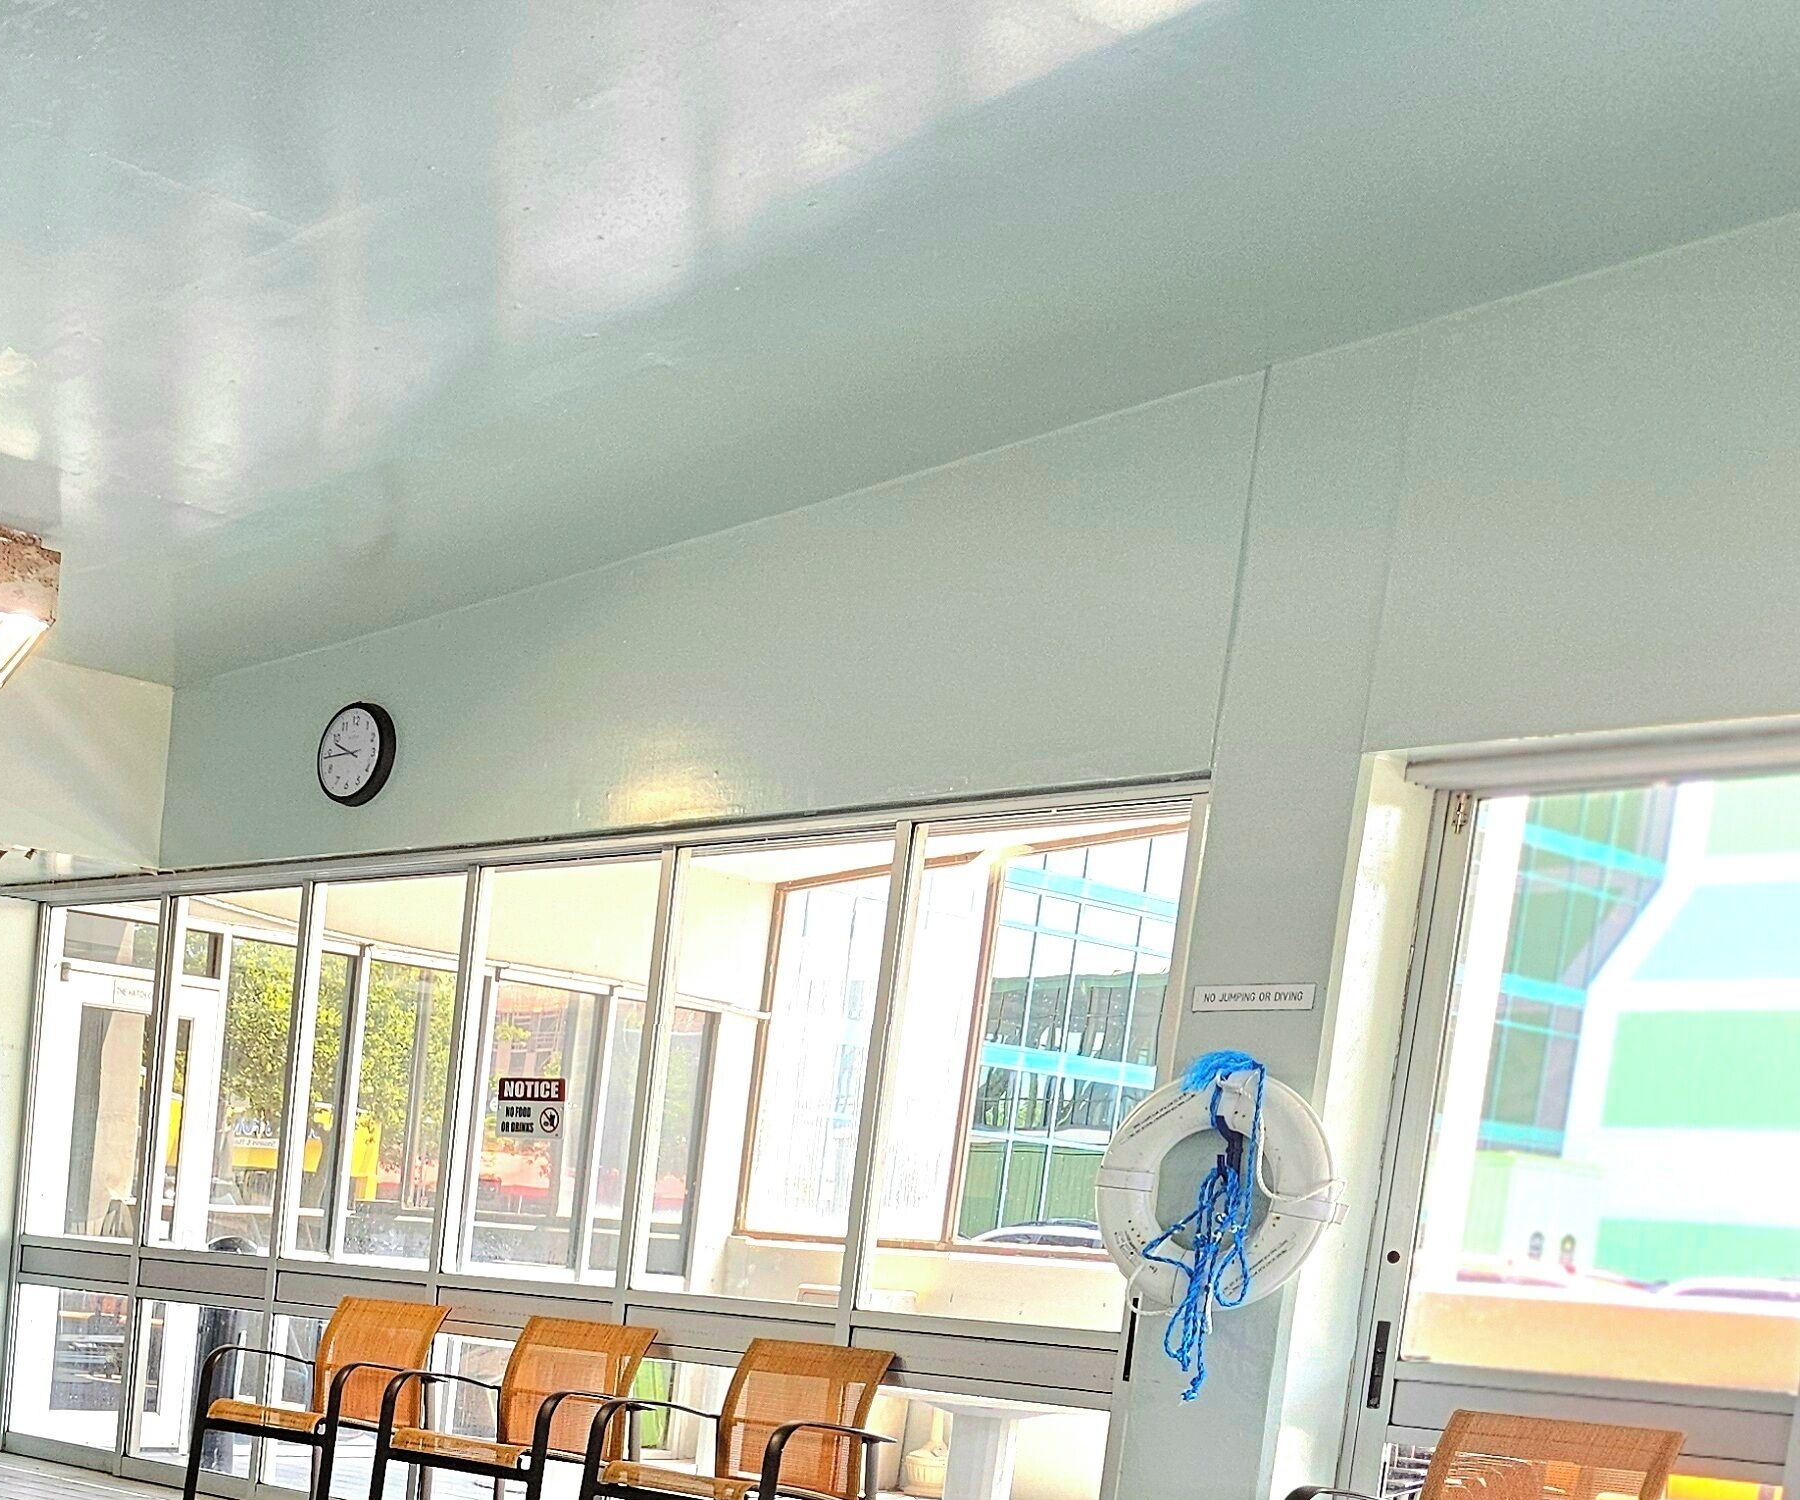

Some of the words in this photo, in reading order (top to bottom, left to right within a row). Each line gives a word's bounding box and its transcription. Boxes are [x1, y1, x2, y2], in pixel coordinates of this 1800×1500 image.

[1203, 993, 1216, 1002] NO
[1218, 991, 1256, 1002] JUMPING
[1258, 991, 1271, 1002] OR
[1274, 991, 1304, 1002] DIVING
[503, 1080, 559, 1099] NOTICE
[505, 1105, 514, 1118] NO
[515, 1105, 532, 1118] FOOD
[501, 1120, 510, 1133] OR
[511, 1121, 534, 1134] DRINKS
